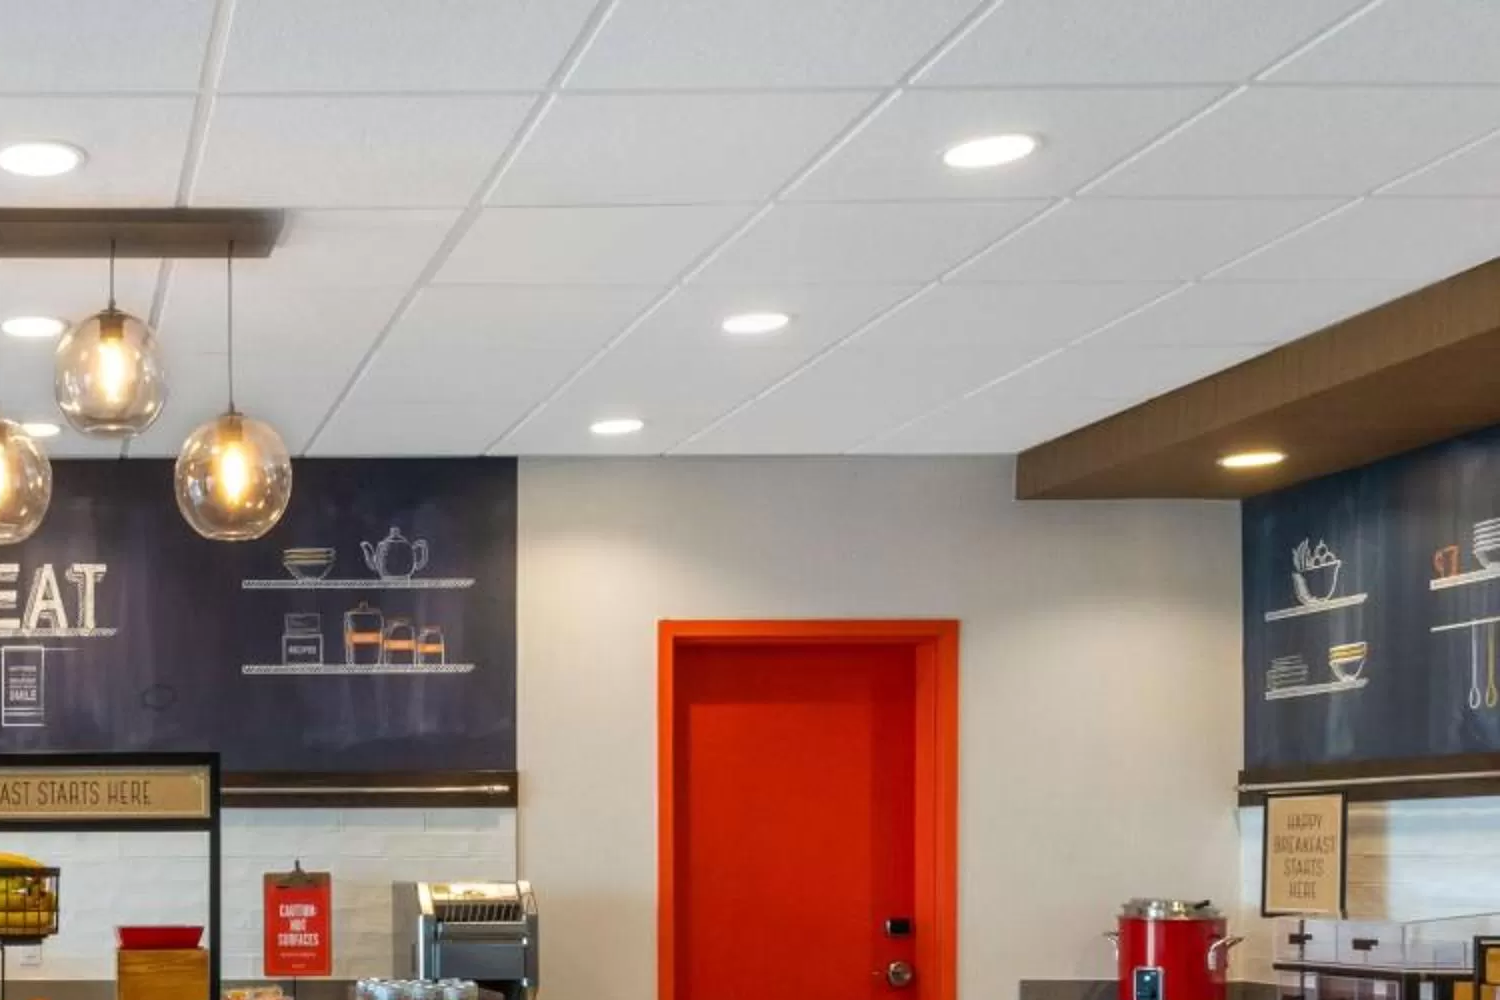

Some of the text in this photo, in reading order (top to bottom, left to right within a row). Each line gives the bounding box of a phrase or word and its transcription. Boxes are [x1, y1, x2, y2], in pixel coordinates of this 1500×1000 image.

[36, 781, 100, 806] STARTS
[107, 781, 152, 806] HERE
[1286, 813, 1324, 831] HAPPY
[1273, 835, 1336, 854] BREAKFAST
[1283, 857, 1325, 877] STARTS
[1289, 880, 1317, 900] HERE
